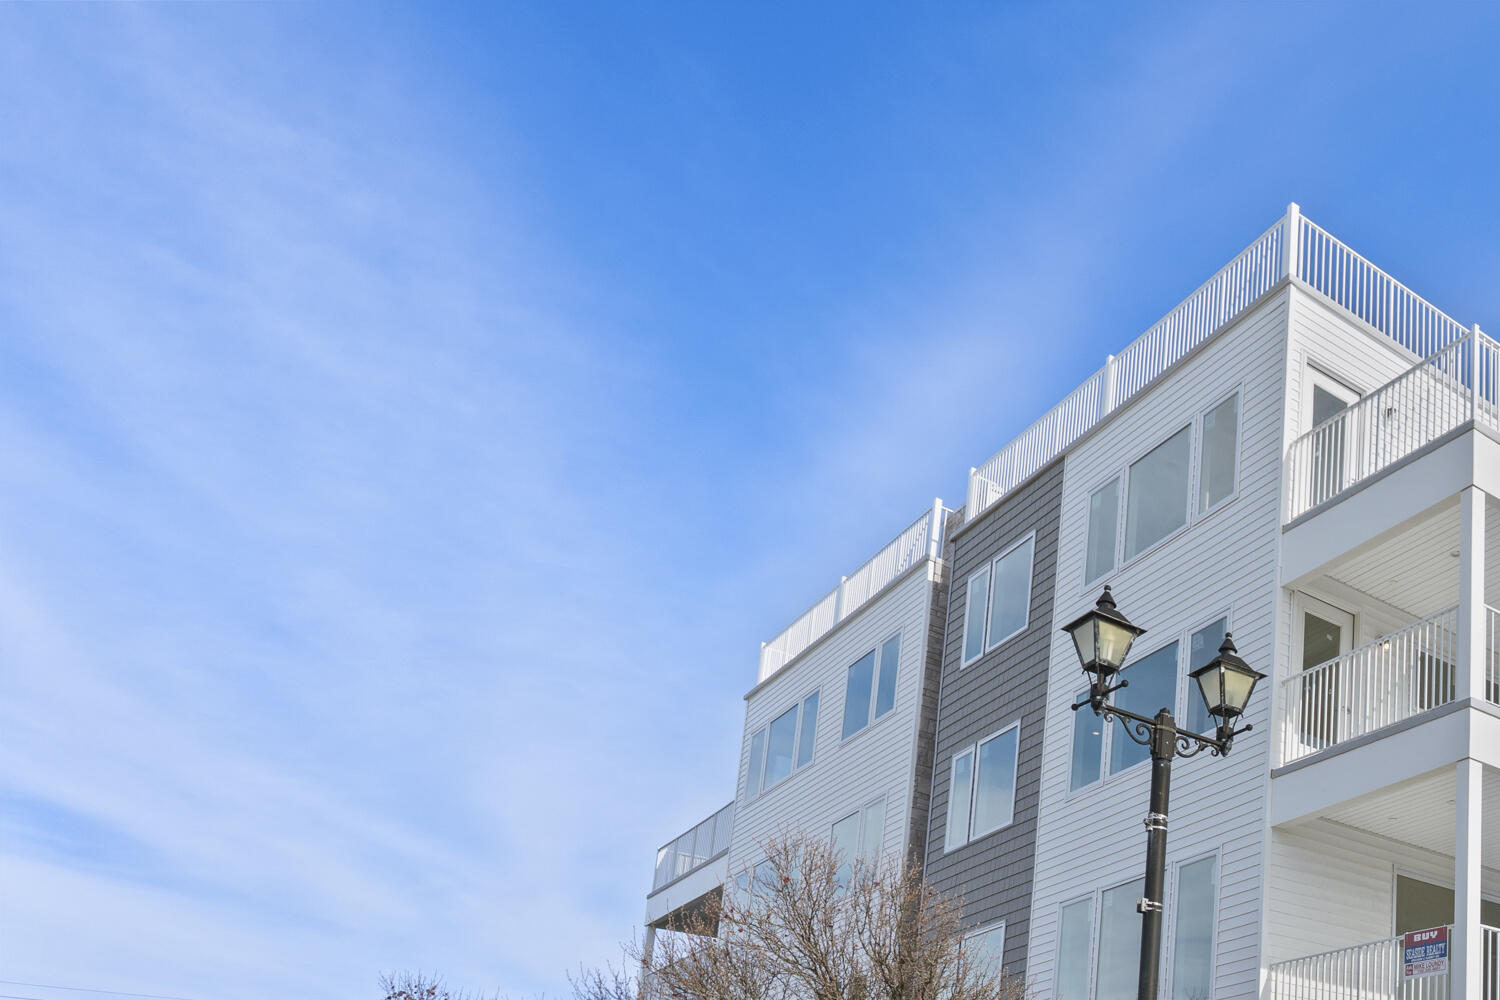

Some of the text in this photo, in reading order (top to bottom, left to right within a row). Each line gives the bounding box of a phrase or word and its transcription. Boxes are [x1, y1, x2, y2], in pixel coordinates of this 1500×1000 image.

[1414, 931, 1438, 942] BUY
[1406, 946, 1426, 960] SEASIDE
[1426, 942, 1446, 956] REALTY
